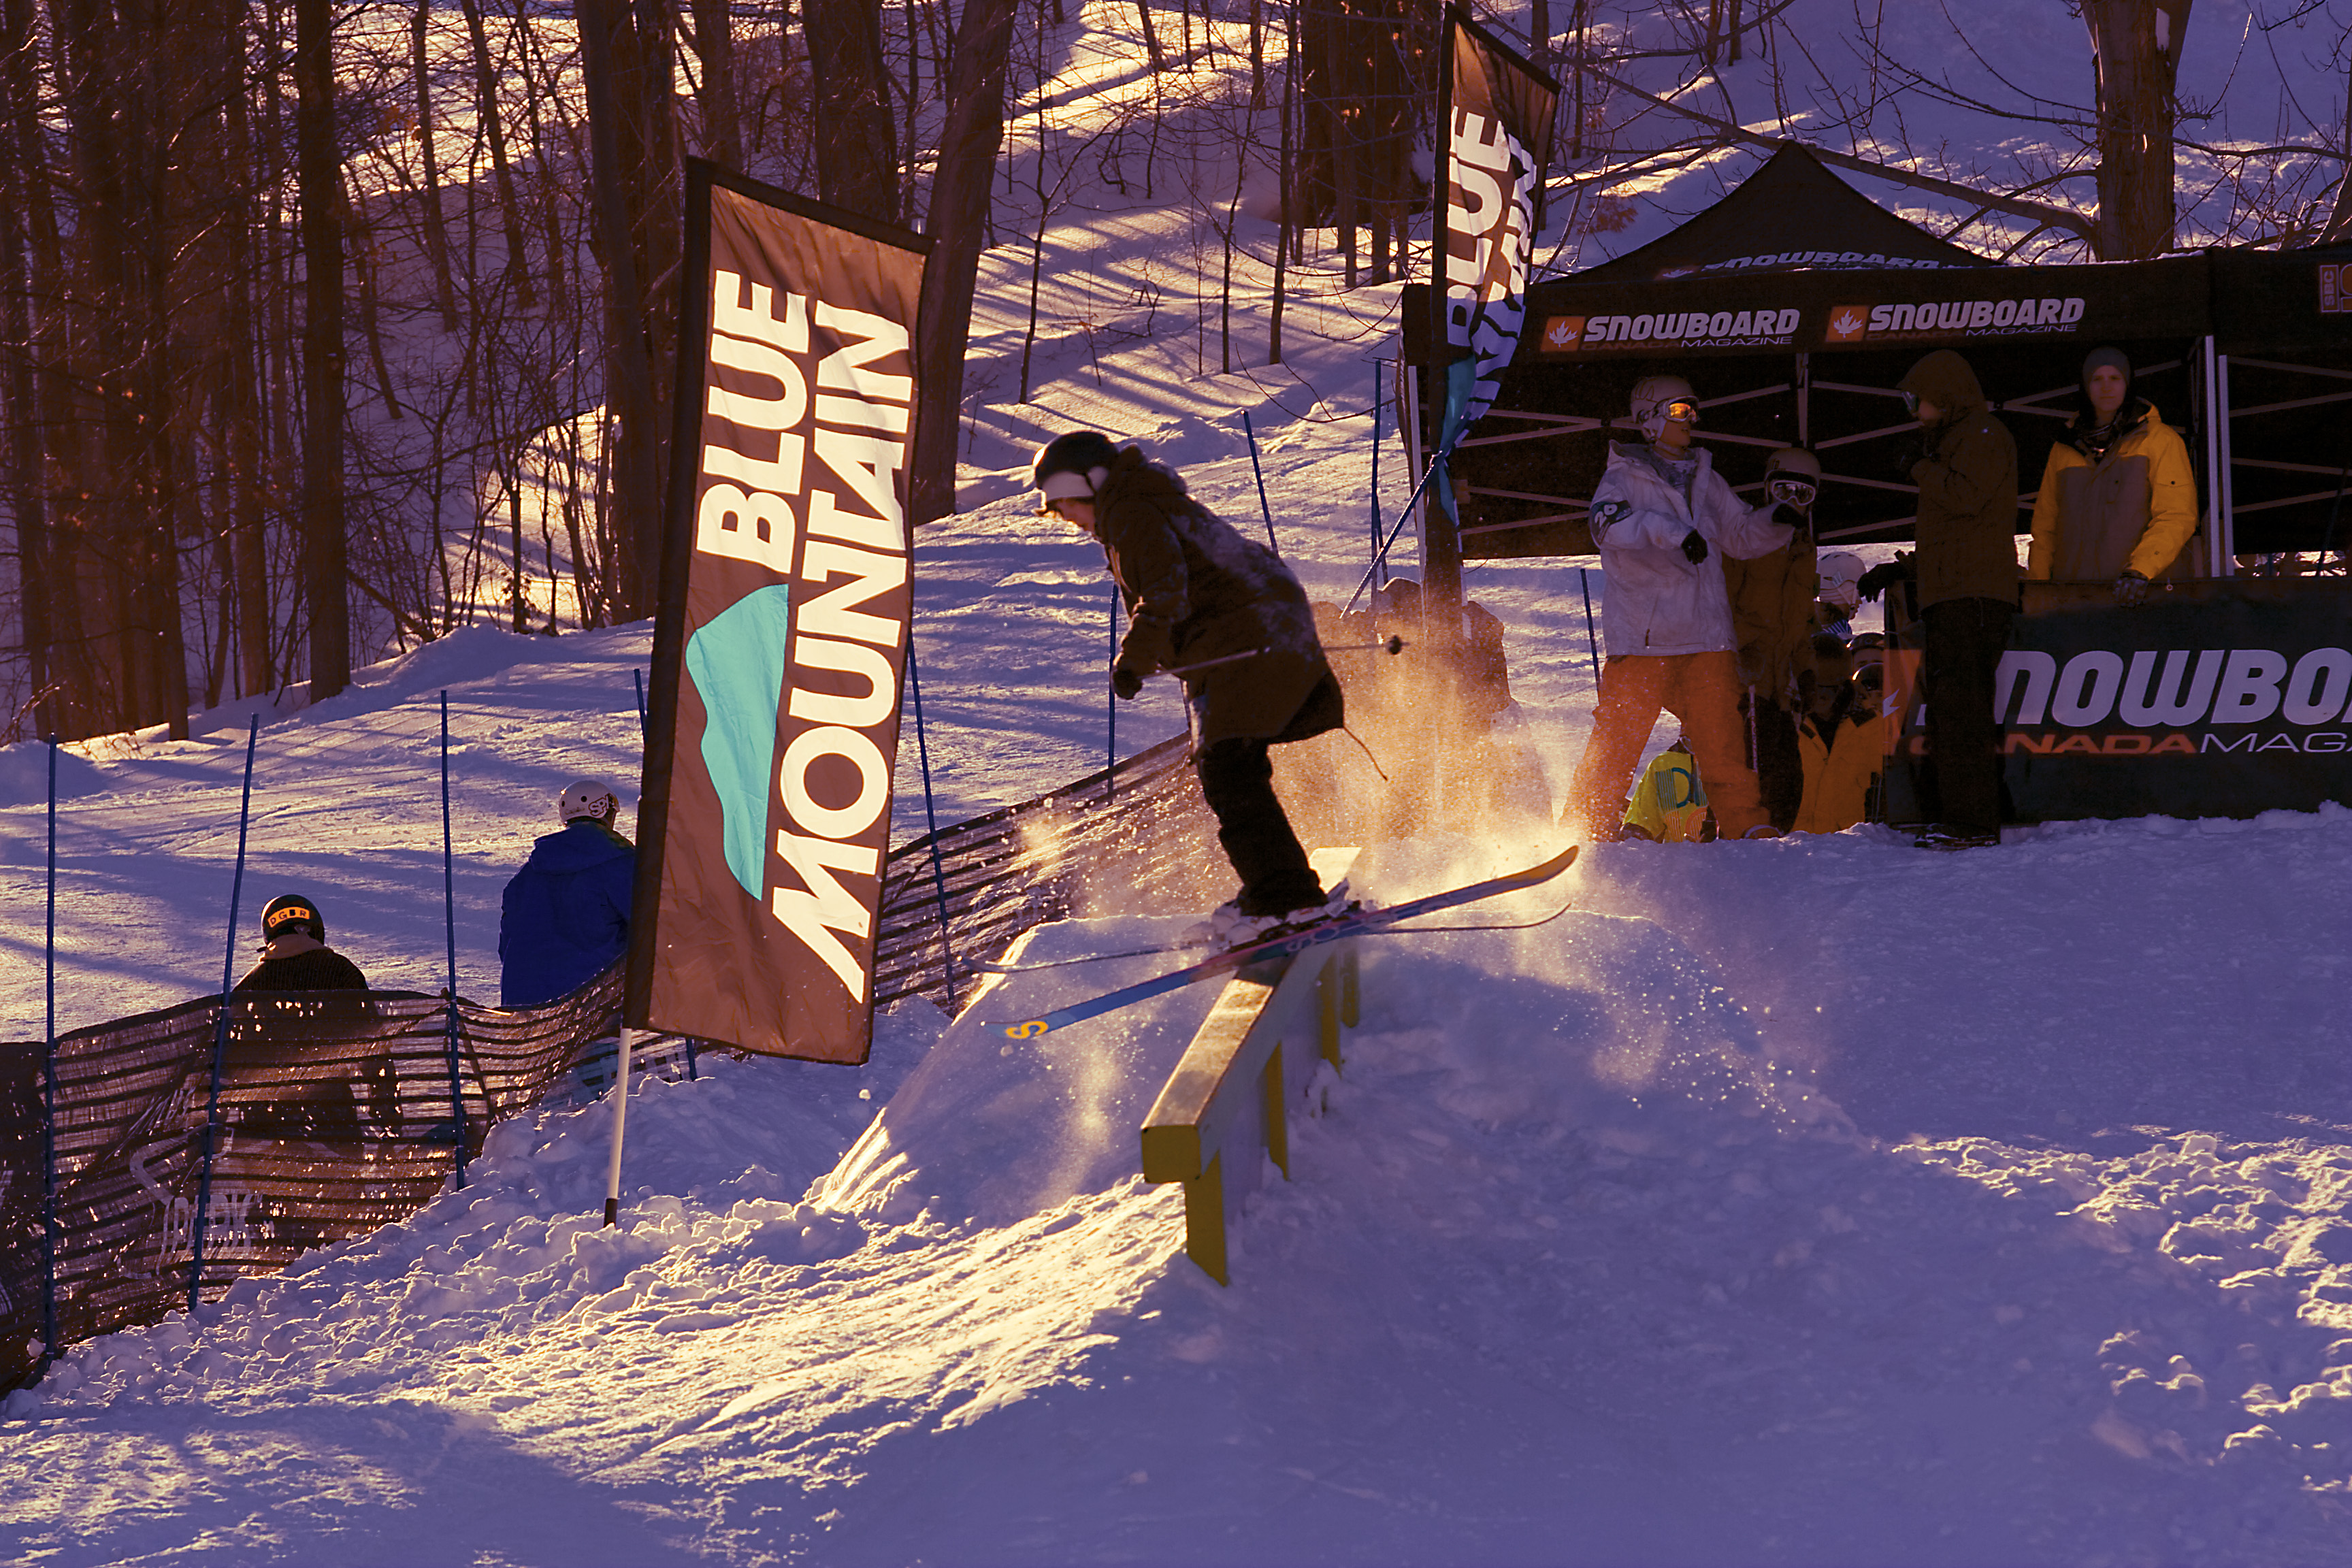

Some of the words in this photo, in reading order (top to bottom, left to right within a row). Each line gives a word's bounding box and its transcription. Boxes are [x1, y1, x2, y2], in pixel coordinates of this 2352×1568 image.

[2323, 270, 2335, 306] SBC
[1584, 308, 1801, 342] SNOWBOARD
[1868, 297, 2086, 331] SNOWBOARD
[1965, 323, 2078, 337] MAGAZINE
[1681, 336, 1793, 348] MAGAZINE
[696, 270, 809, 574] BLUE
[772, 299, 913, 1004] MOUNTAIN
[1916, 647, 2352, 728] NOWBO
[1910, 733, 2199, 755] NADA
[2200, 732, 2352, 753] MAG
